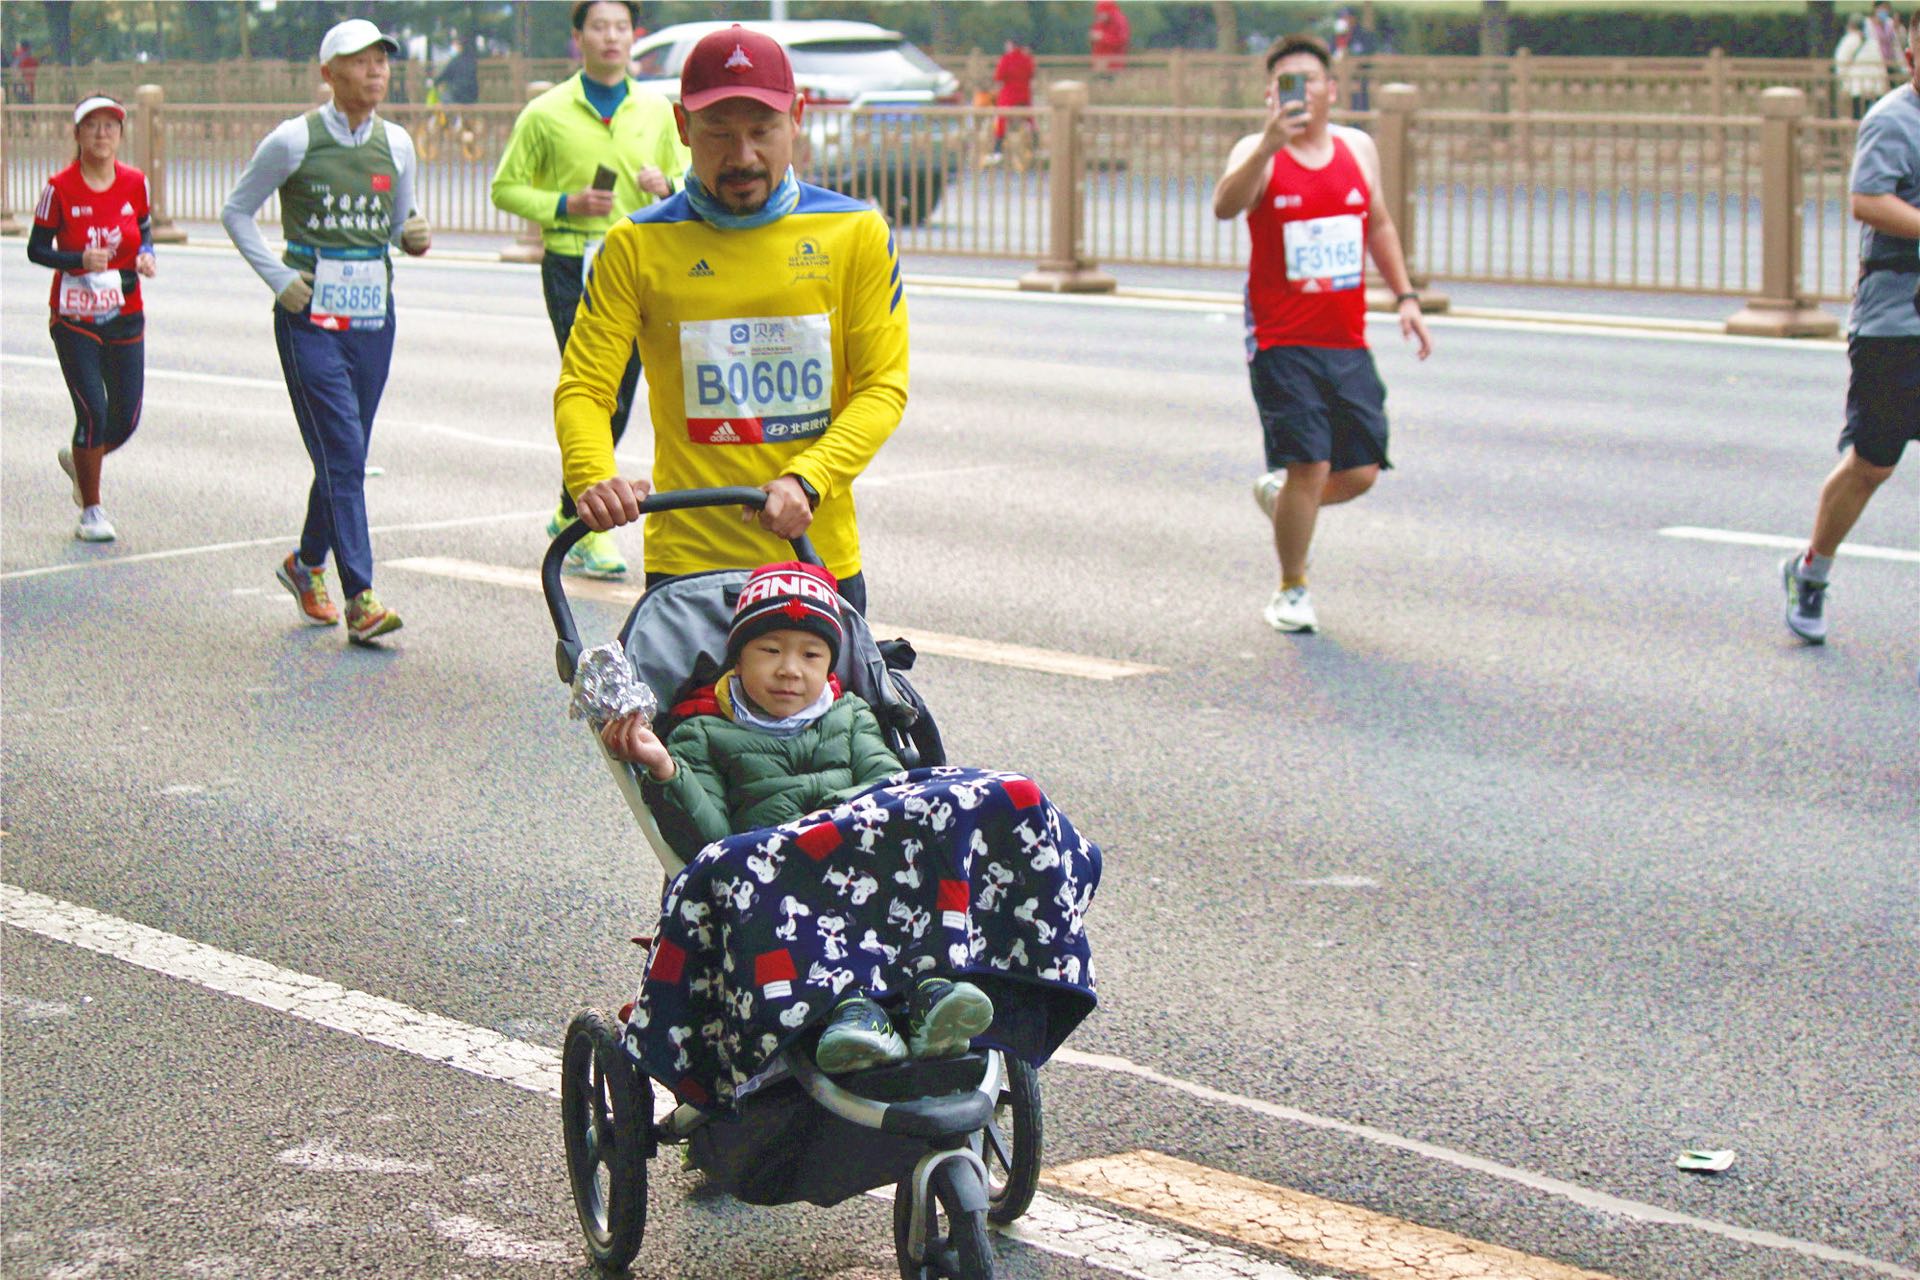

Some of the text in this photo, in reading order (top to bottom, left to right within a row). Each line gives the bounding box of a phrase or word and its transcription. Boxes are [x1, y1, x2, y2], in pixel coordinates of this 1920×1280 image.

[1295, 240, 1358, 272] F3165
[321, 284, 382, 310] F3856
[753, 322, 785, 338] 贝壳
[697, 358, 823, 406] B0606
[709, 433, 741, 443] adidas
